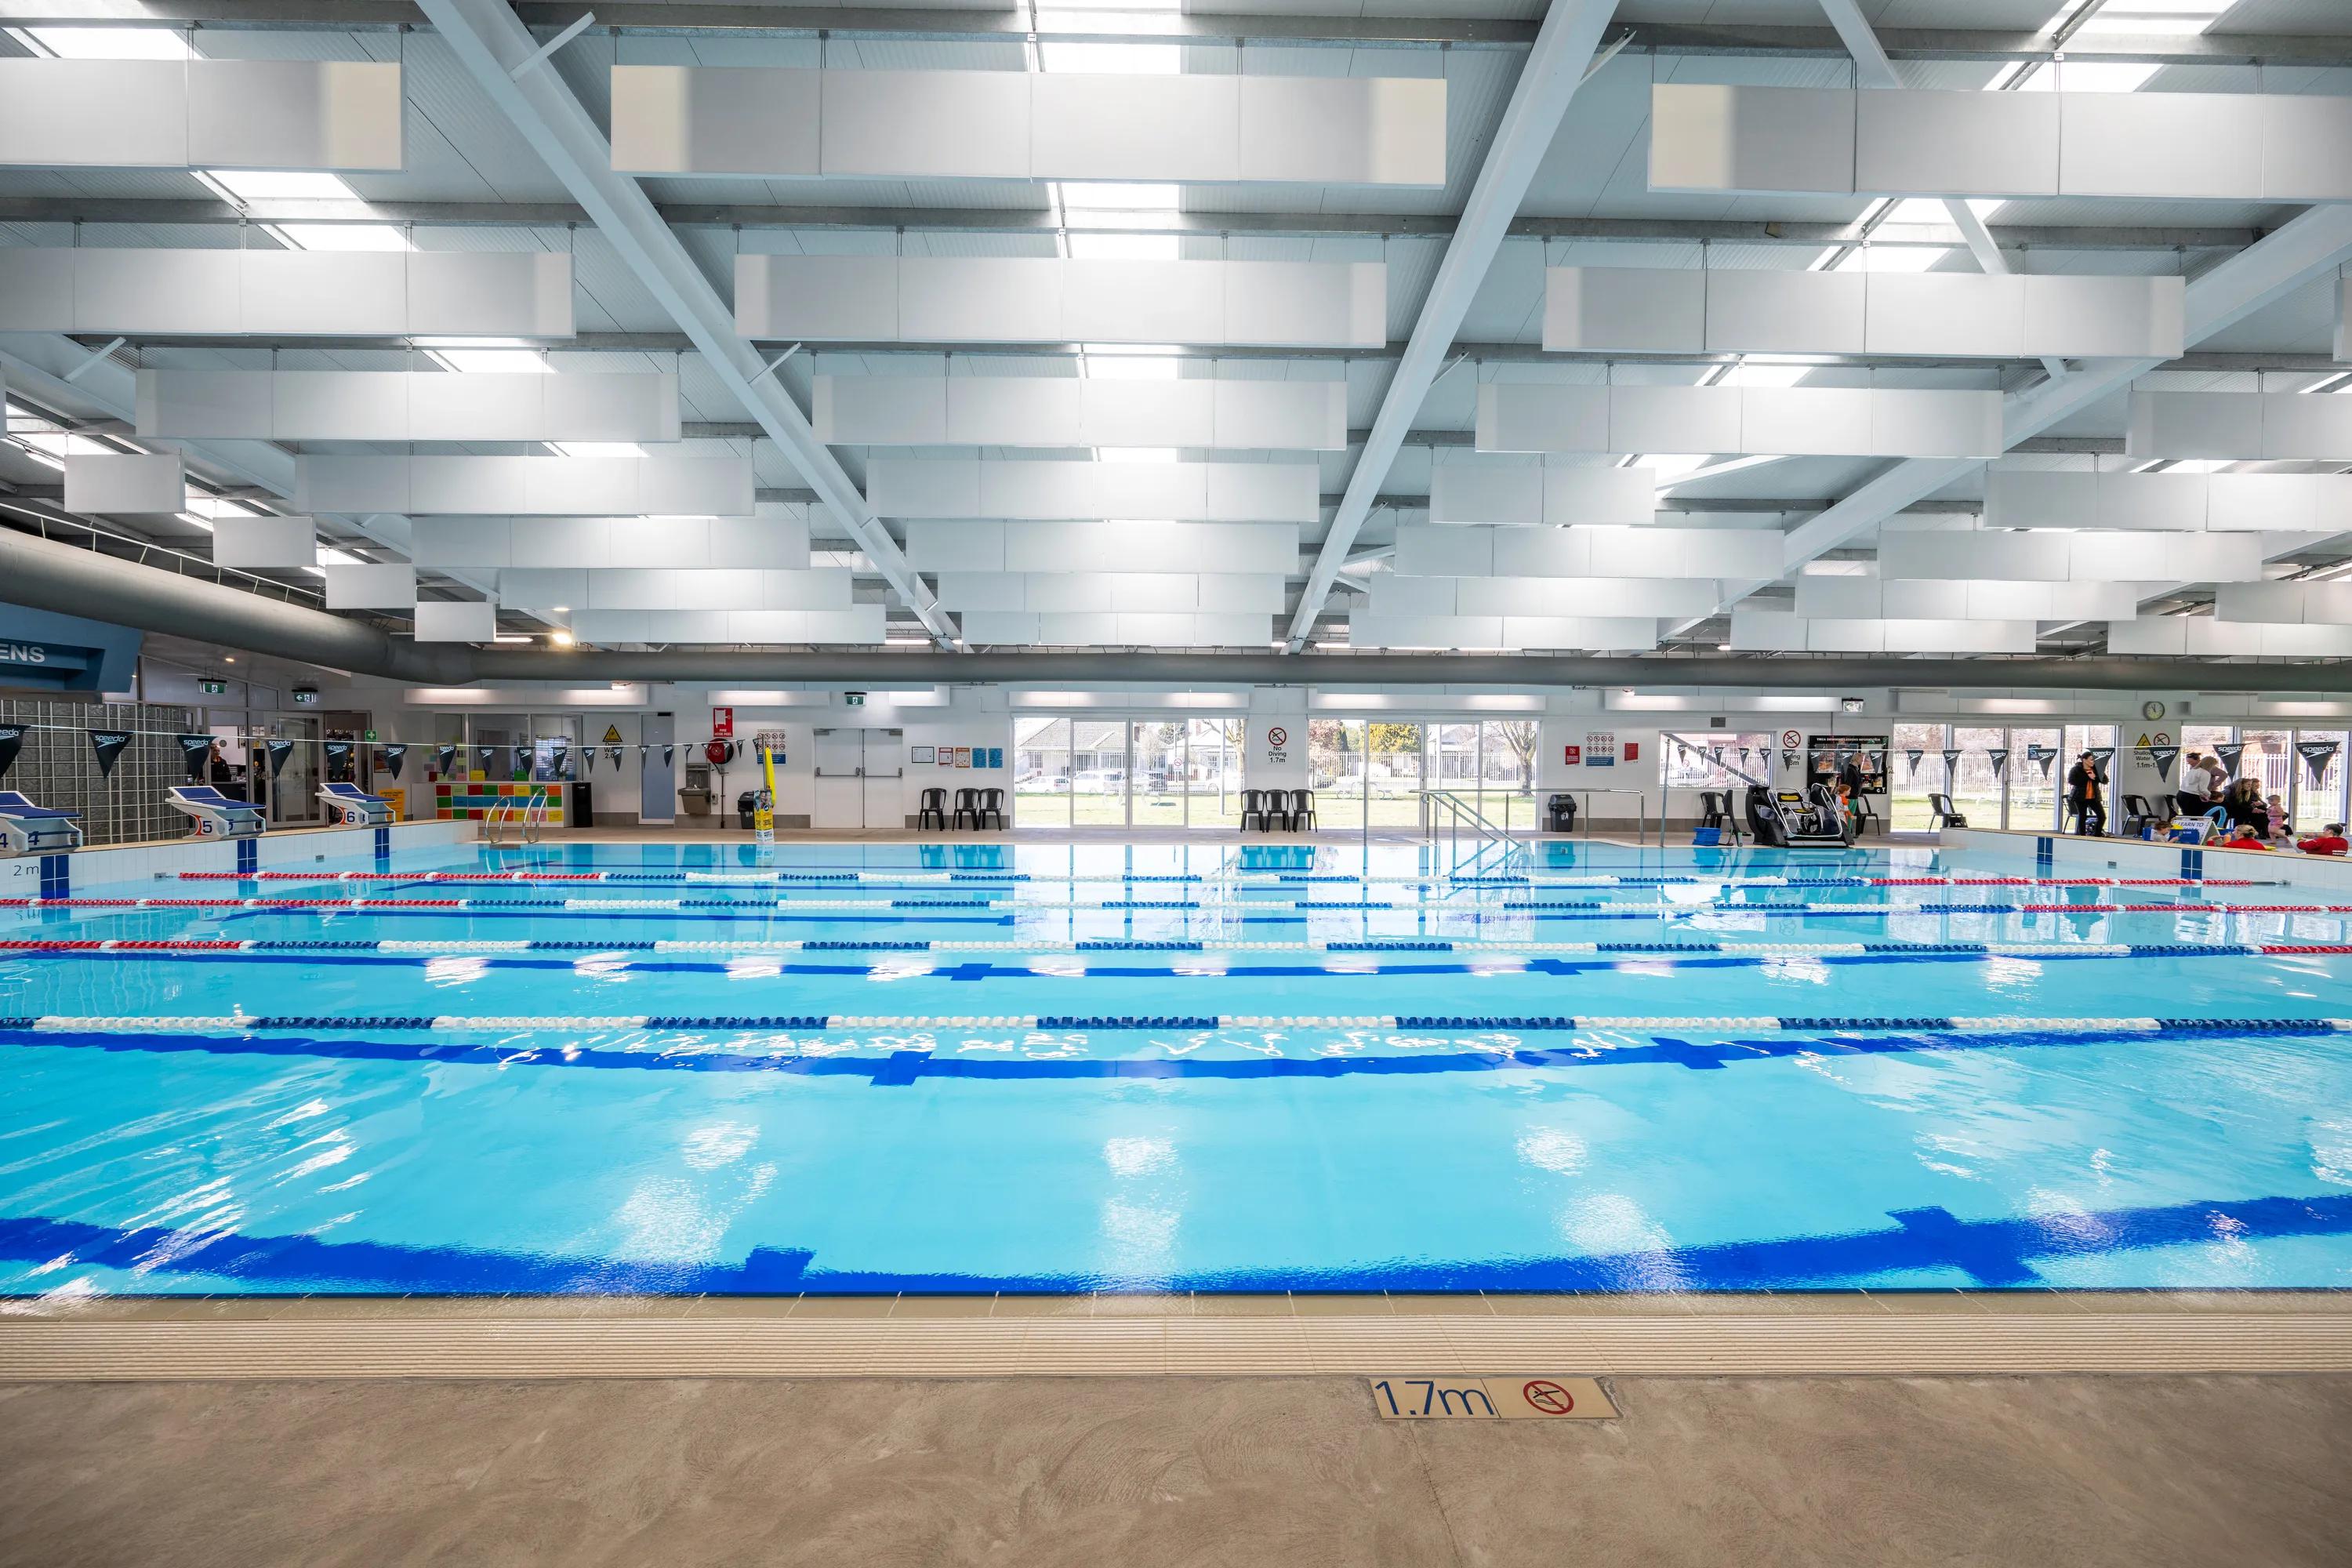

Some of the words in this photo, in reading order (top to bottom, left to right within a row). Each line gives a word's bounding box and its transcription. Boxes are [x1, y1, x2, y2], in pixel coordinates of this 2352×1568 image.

[347, 811, 355, 822] 6
[202, 820, 212, 833] 5
[13, 865, 22, 877] 2
[26, 866, 39, 875] m
[1374, 1381, 1494, 1415] 1.7m
